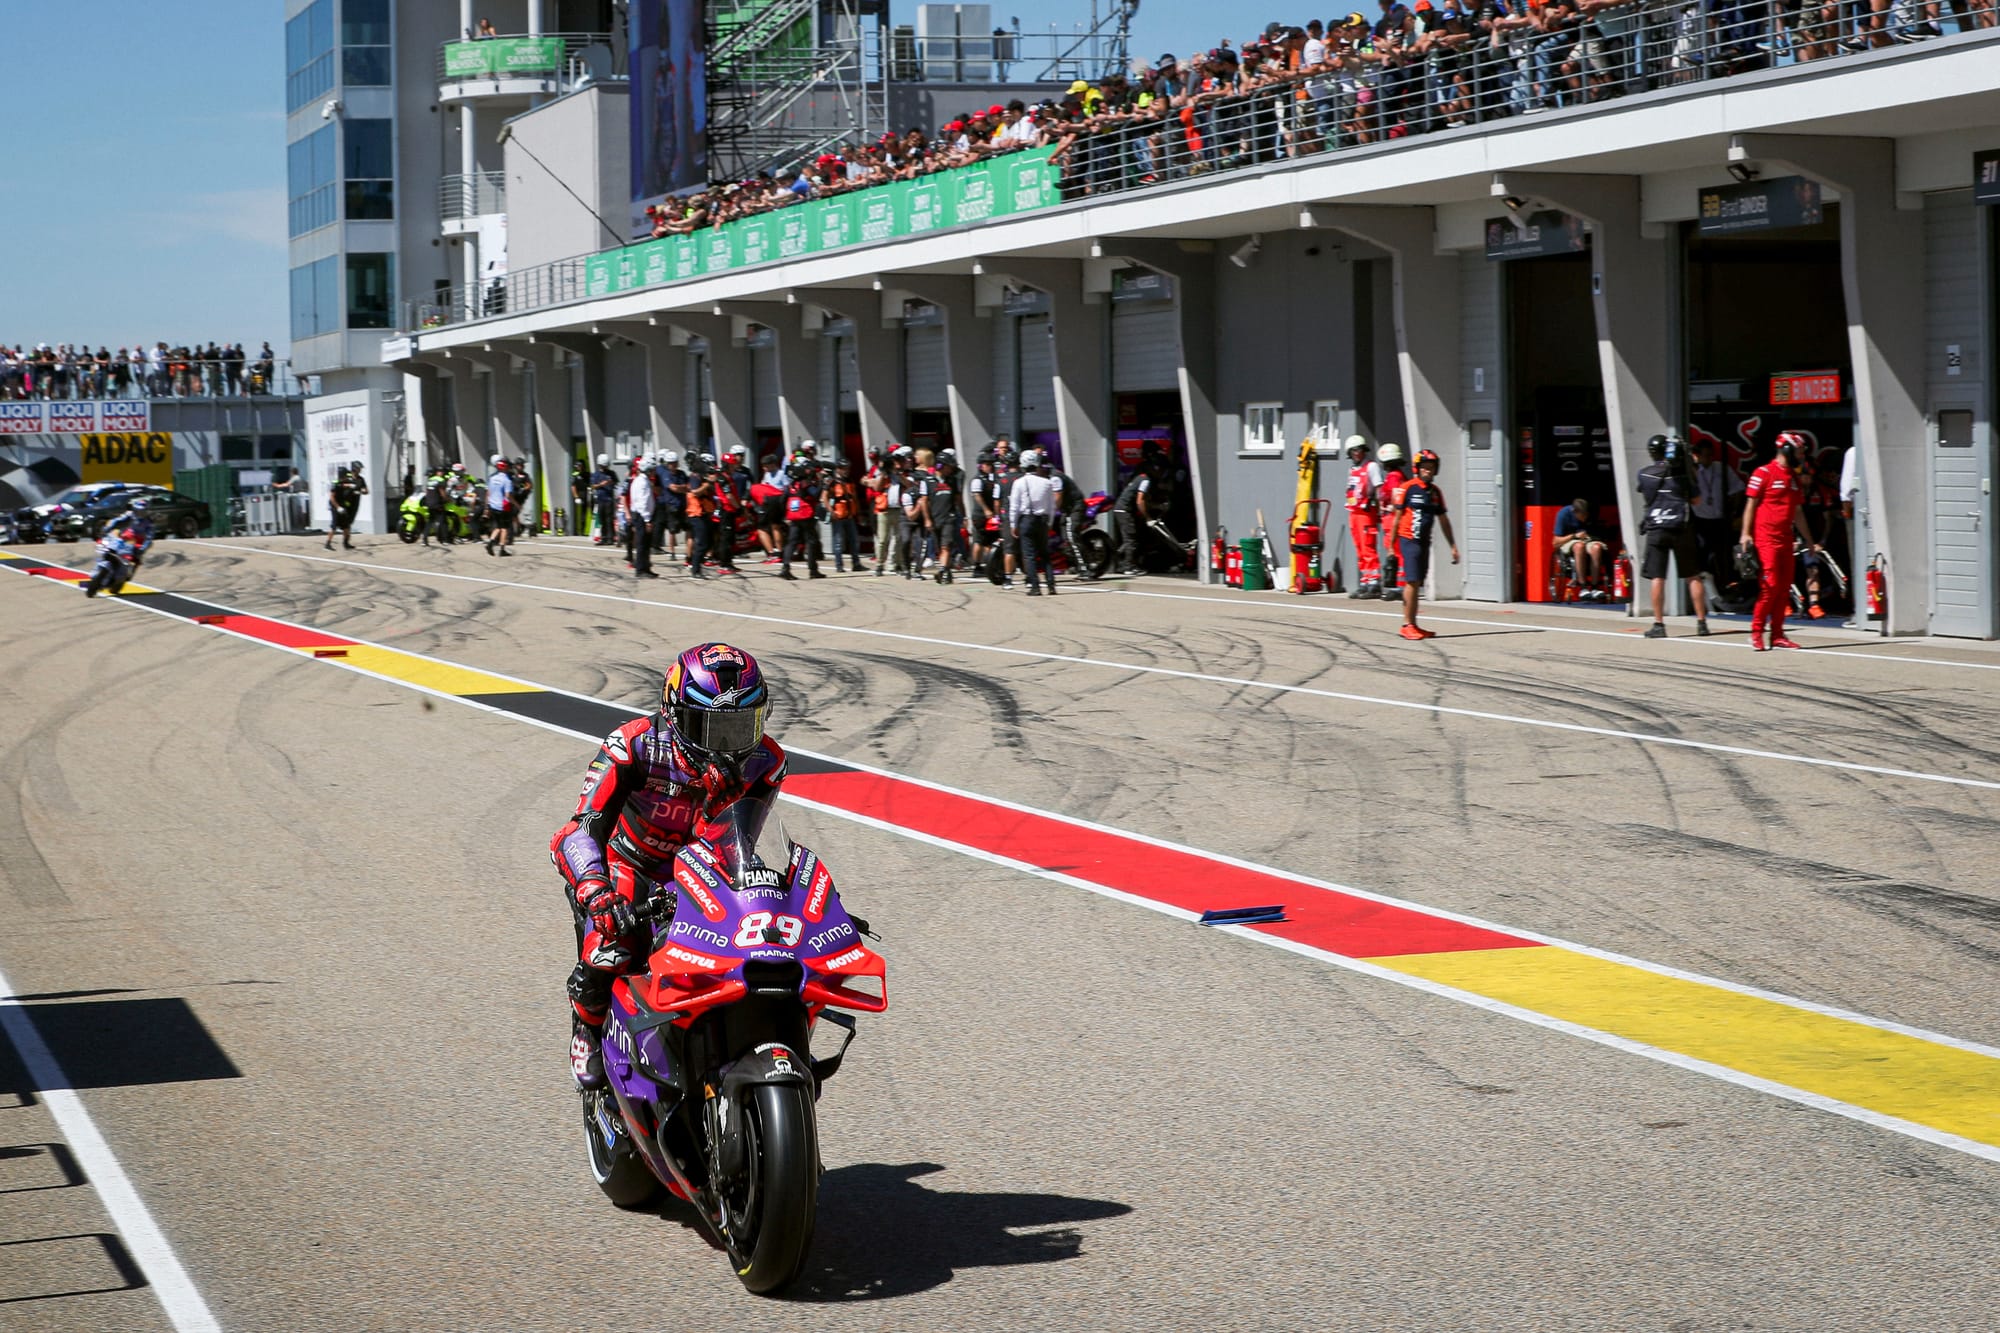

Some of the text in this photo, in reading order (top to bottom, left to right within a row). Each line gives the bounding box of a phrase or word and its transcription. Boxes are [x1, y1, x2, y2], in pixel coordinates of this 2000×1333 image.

[1793, 379, 1835, 400] BINDER
[51, 404, 93, 417] LIQUI
[103, 403, 145, 417] LIQUI
[51, 418, 93, 431] MOLY
[103, 416, 146, 431] MOLY
[84, 434, 166, 465] ADAC
[745, 869, 779, 888] FIAMM
[678, 869, 719, 914] PRAMAC
[745, 888, 783, 903] prima
[809, 871, 829, 915] PRAMAC
[673, 921, 729, 948] prima
[732, 909, 806, 949] 89
[808, 922, 853, 953] prima
[666, 947, 716, 970] MOTUL
[750, 949, 795, 960] PRAMAC
[825, 949, 865, 971] MOTUL
